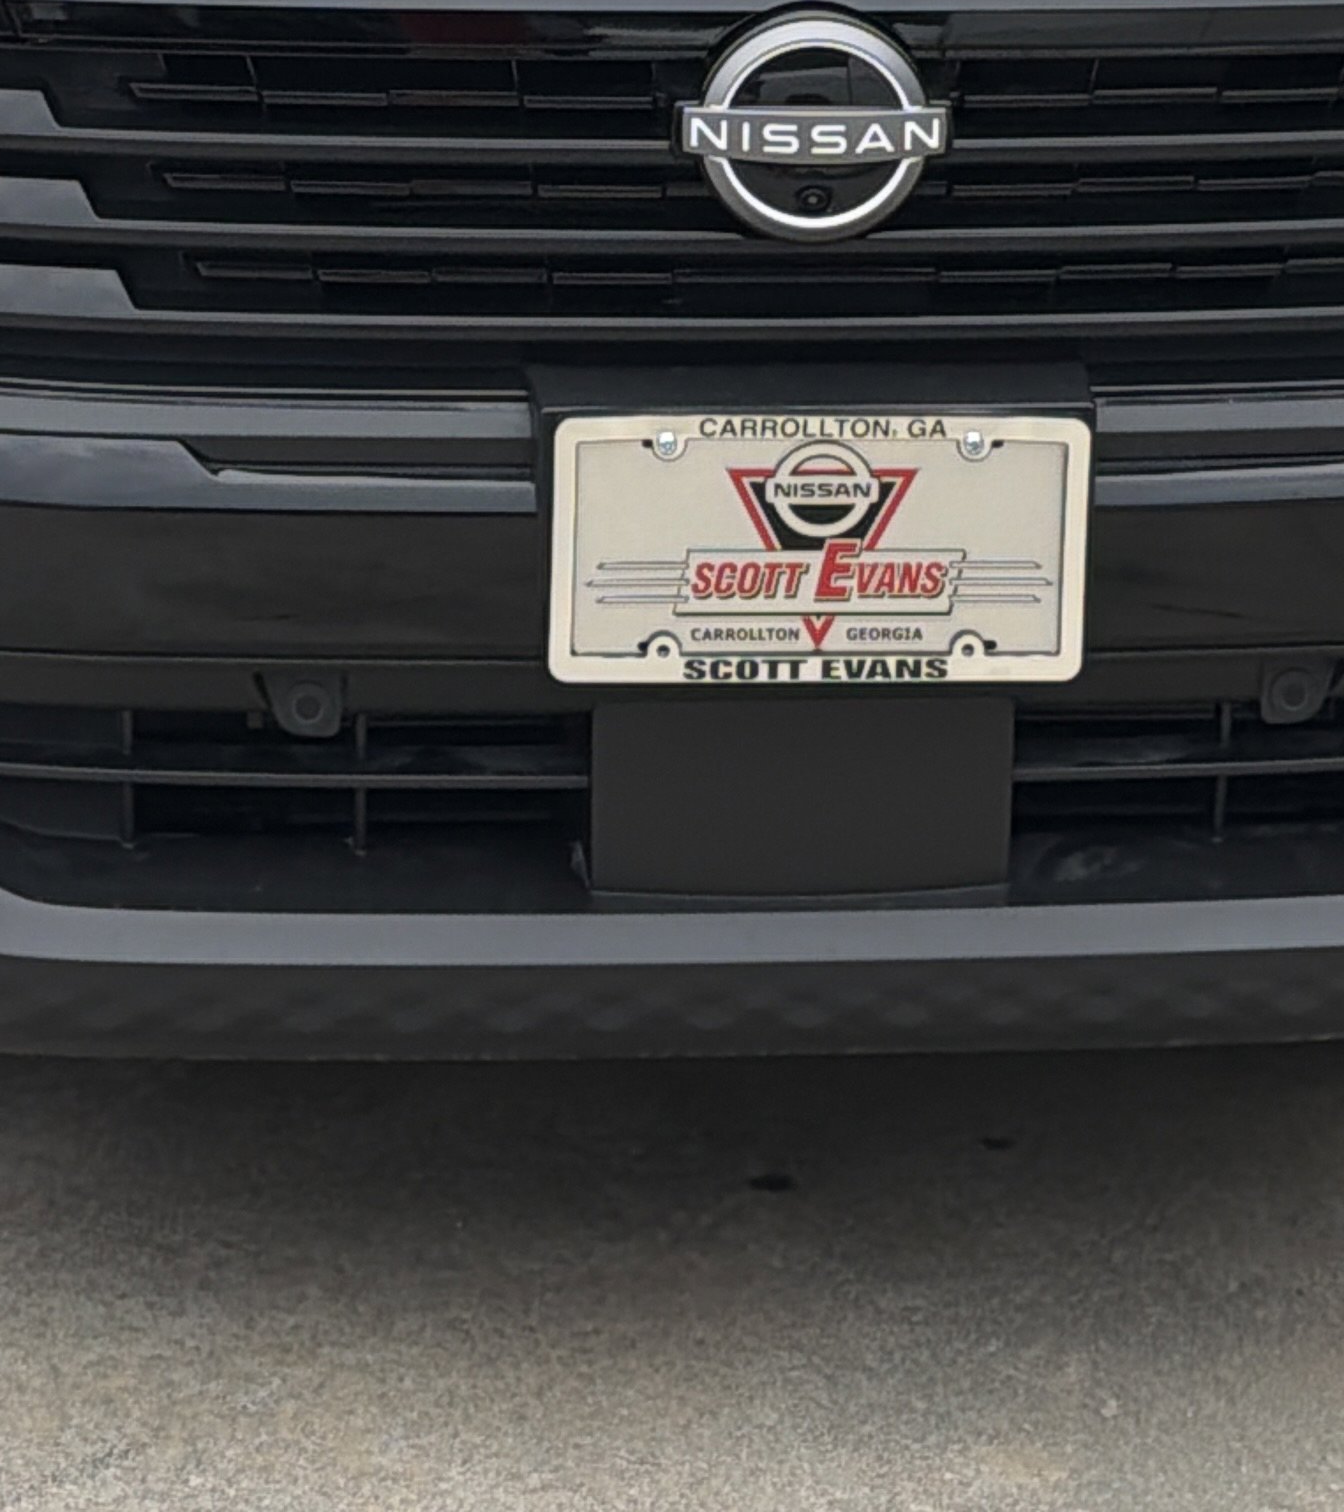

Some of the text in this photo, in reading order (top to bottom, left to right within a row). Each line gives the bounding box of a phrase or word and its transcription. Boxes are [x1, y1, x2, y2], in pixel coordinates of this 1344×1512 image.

[689, 117, 941, 155] NISSAN
[906, 418, 948, 440] GA
[773, 482, 873, 499] NISSAN
[690, 539, 948, 602] SCOTT EVANS
[690, 627, 924, 643] CARROLLTON GEORGIA
[682, 659, 949, 681] SCOTT EVANS
